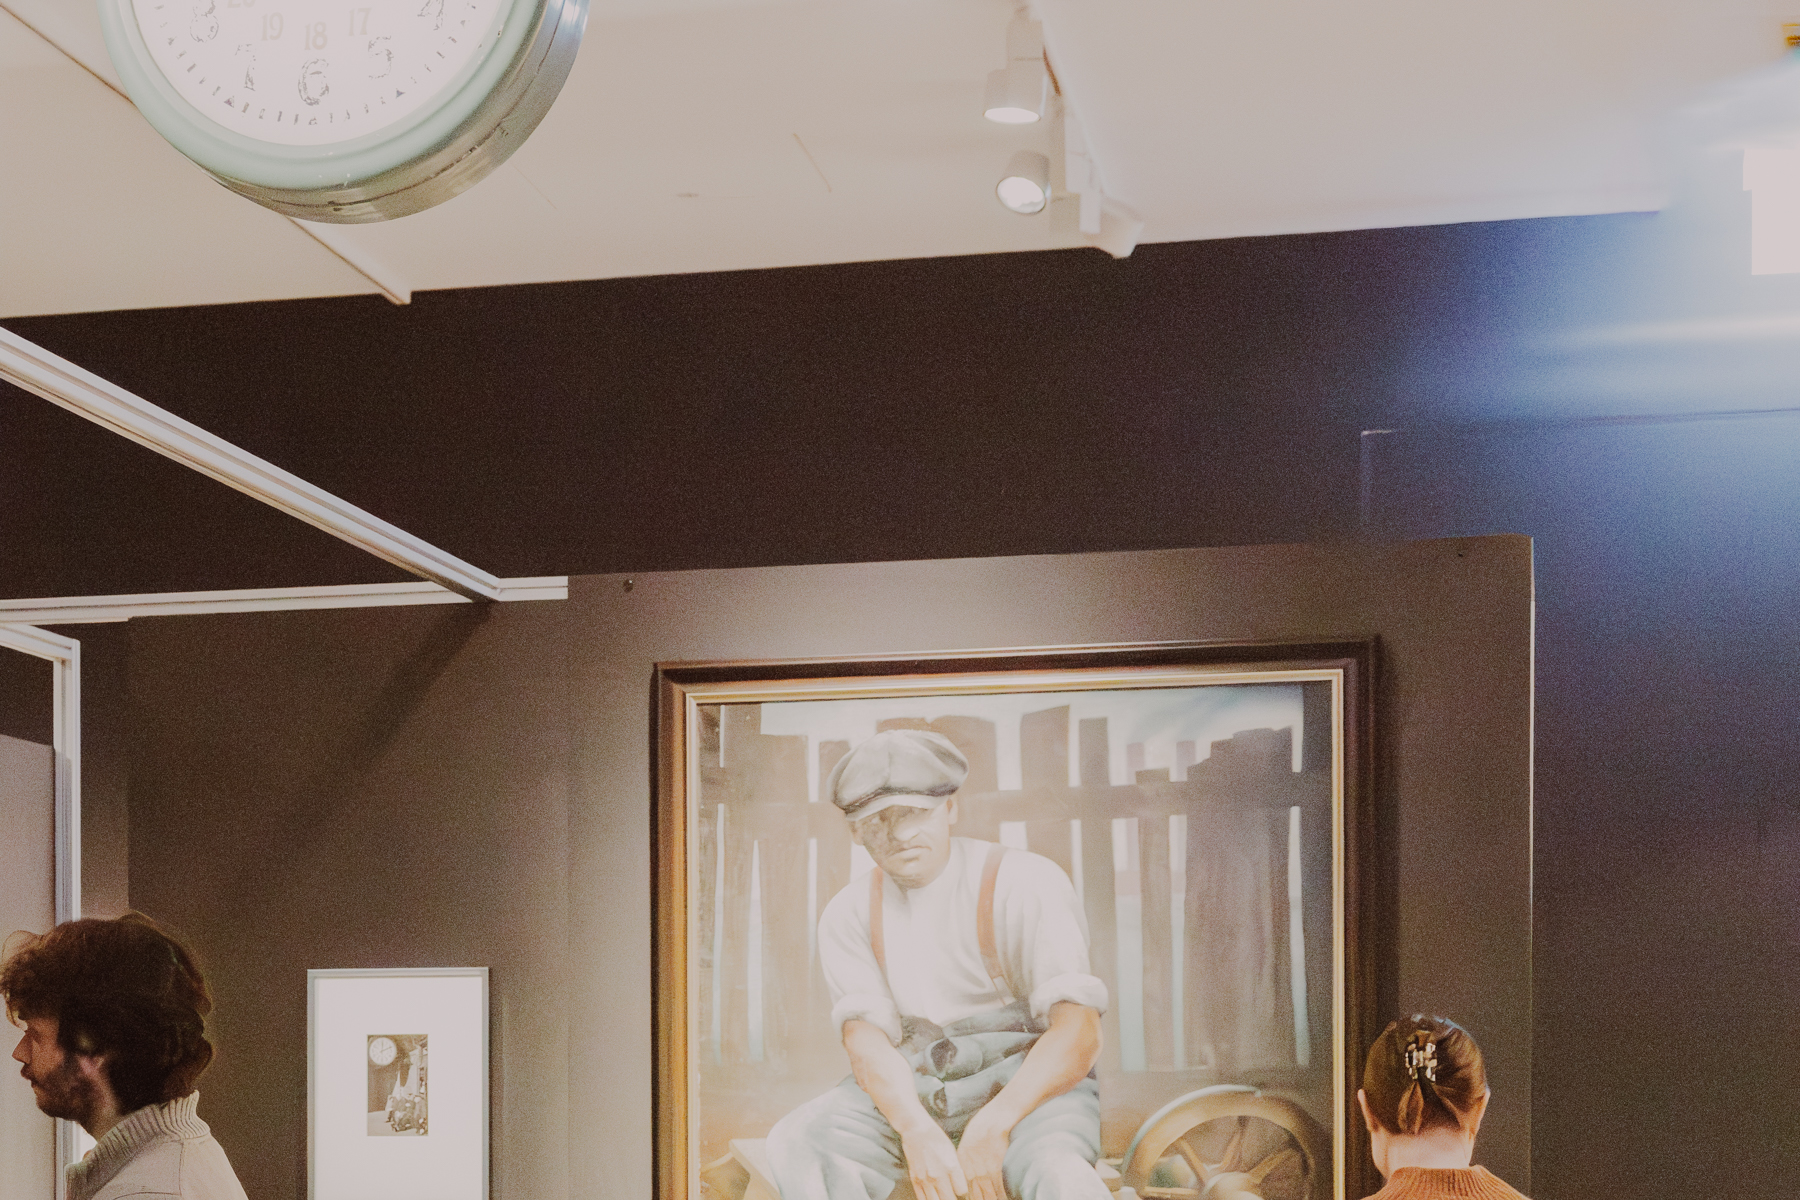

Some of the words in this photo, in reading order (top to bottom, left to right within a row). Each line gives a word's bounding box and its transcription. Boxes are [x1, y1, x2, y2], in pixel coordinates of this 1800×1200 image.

[261, 12, 284, 41] 19
[304, 21, 328, 50] 18
[348, 7, 373, 37] 17
[367, 35, 394, 79] 5
[297, 58, 330, 106] 6
